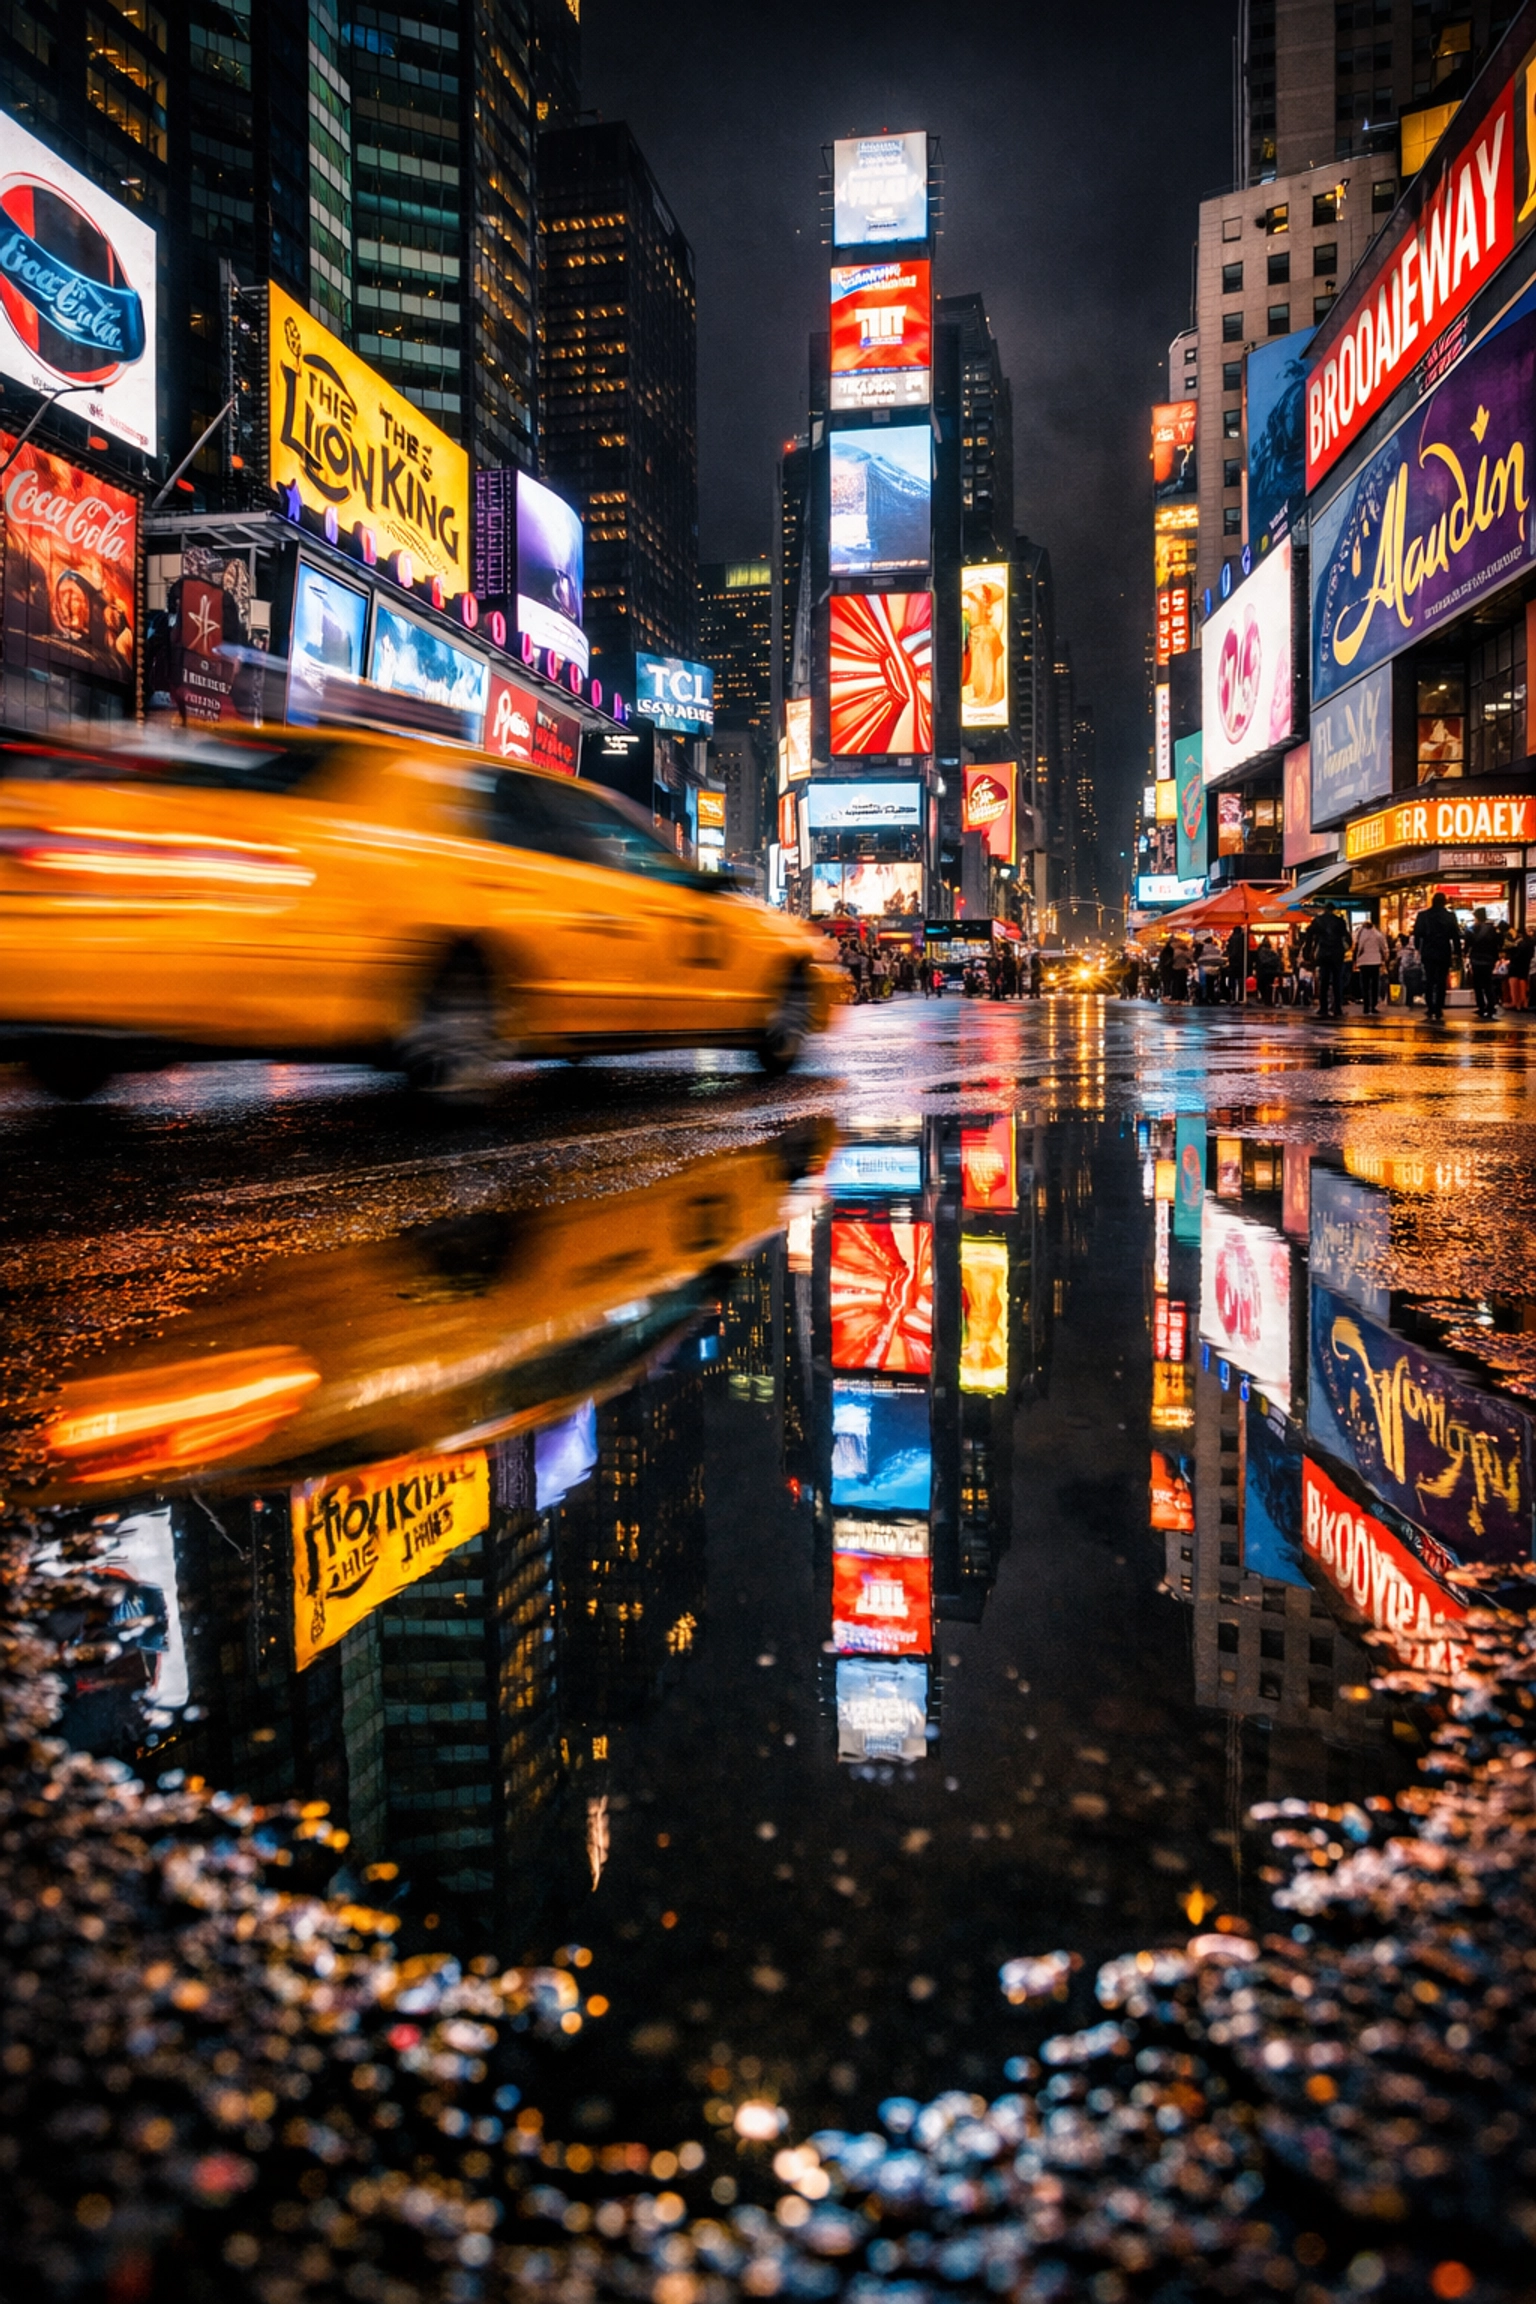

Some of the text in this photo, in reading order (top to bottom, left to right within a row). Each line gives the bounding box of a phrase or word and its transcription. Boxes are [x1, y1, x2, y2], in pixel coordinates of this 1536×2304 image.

[5, 469, 135, 562] Coca-Cola
[380, 444, 459, 565] KING
[645, 663, 711, 707] TCL
